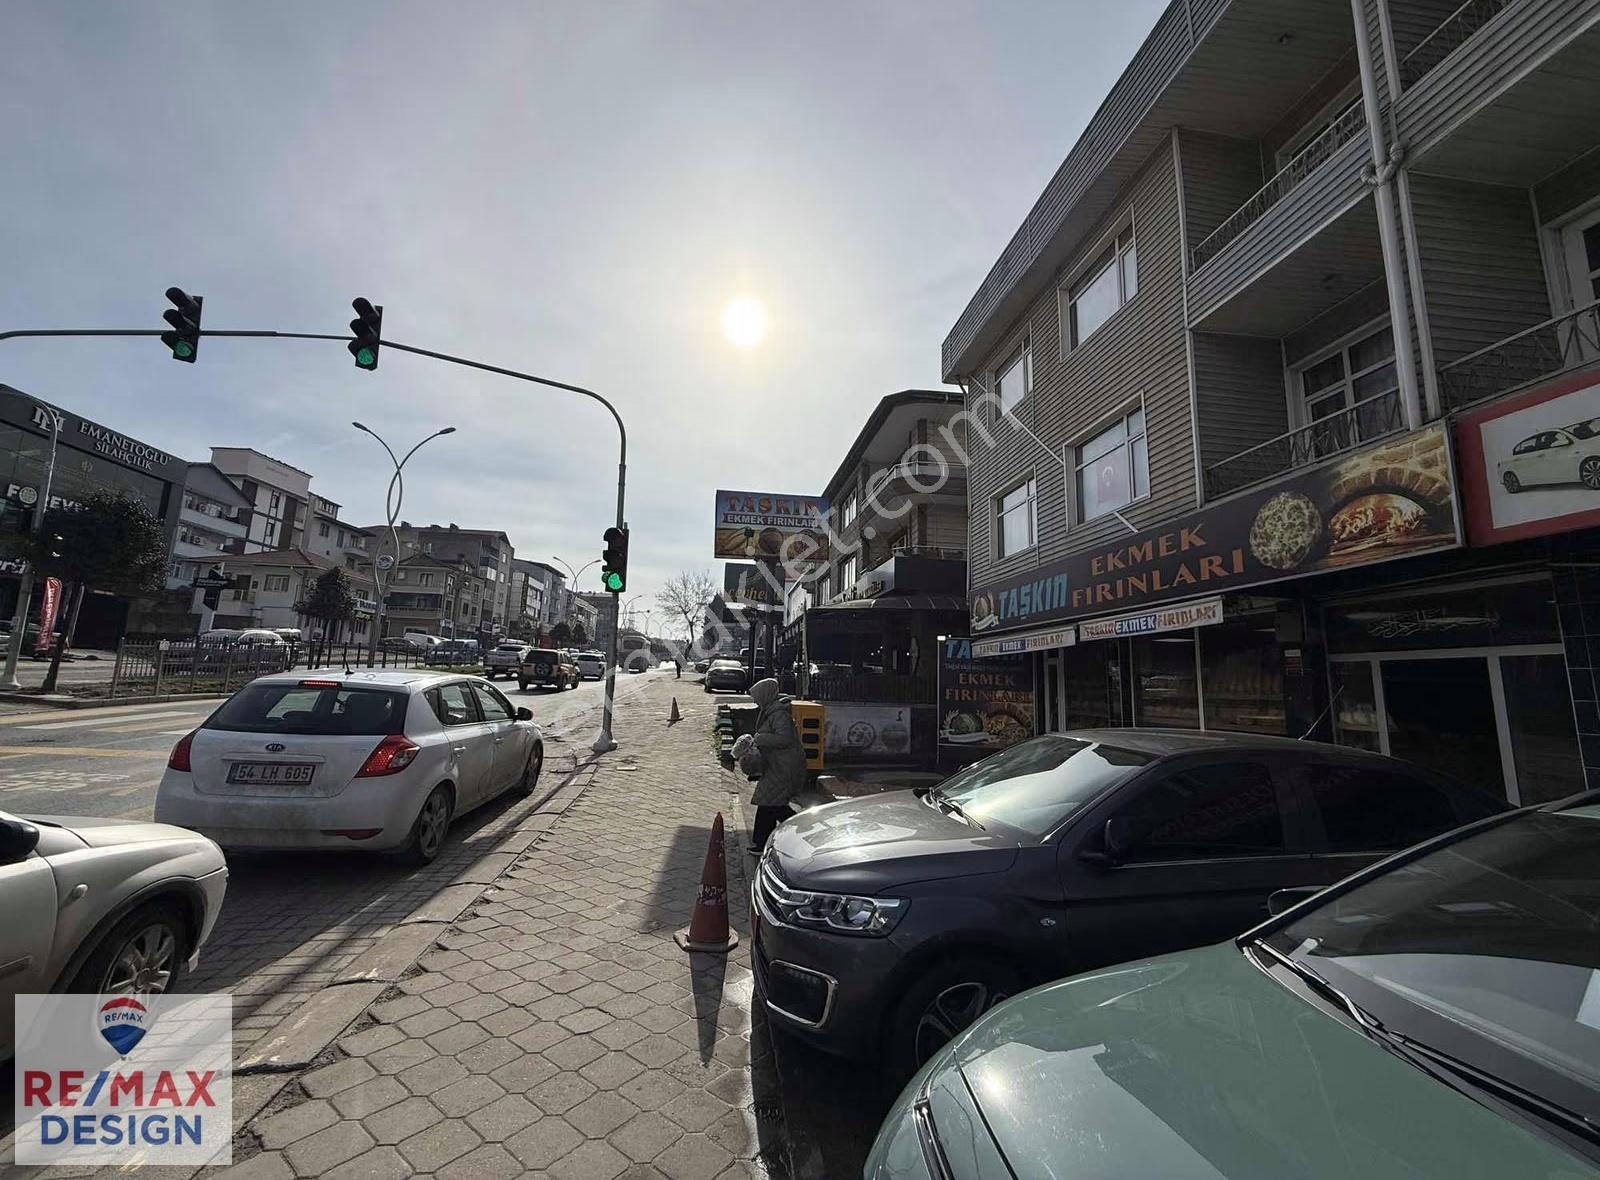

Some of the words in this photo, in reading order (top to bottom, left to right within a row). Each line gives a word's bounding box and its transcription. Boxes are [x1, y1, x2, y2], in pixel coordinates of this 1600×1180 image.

[727, 514, 766, 525] EKMEK
[1091, 523, 1206, 577] EKMEK
[999, 573, 1068, 620] TAŞKIN
[1072, 548, 1244, 608] FIRINLARI
[1115, 615, 1156, 633] EKMEK
[960, 673, 1016, 686] EKMEK
[238, 765, 254, 779] 54
[260, 765, 278, 779] LH
[284, 766, 311, 779] 605
